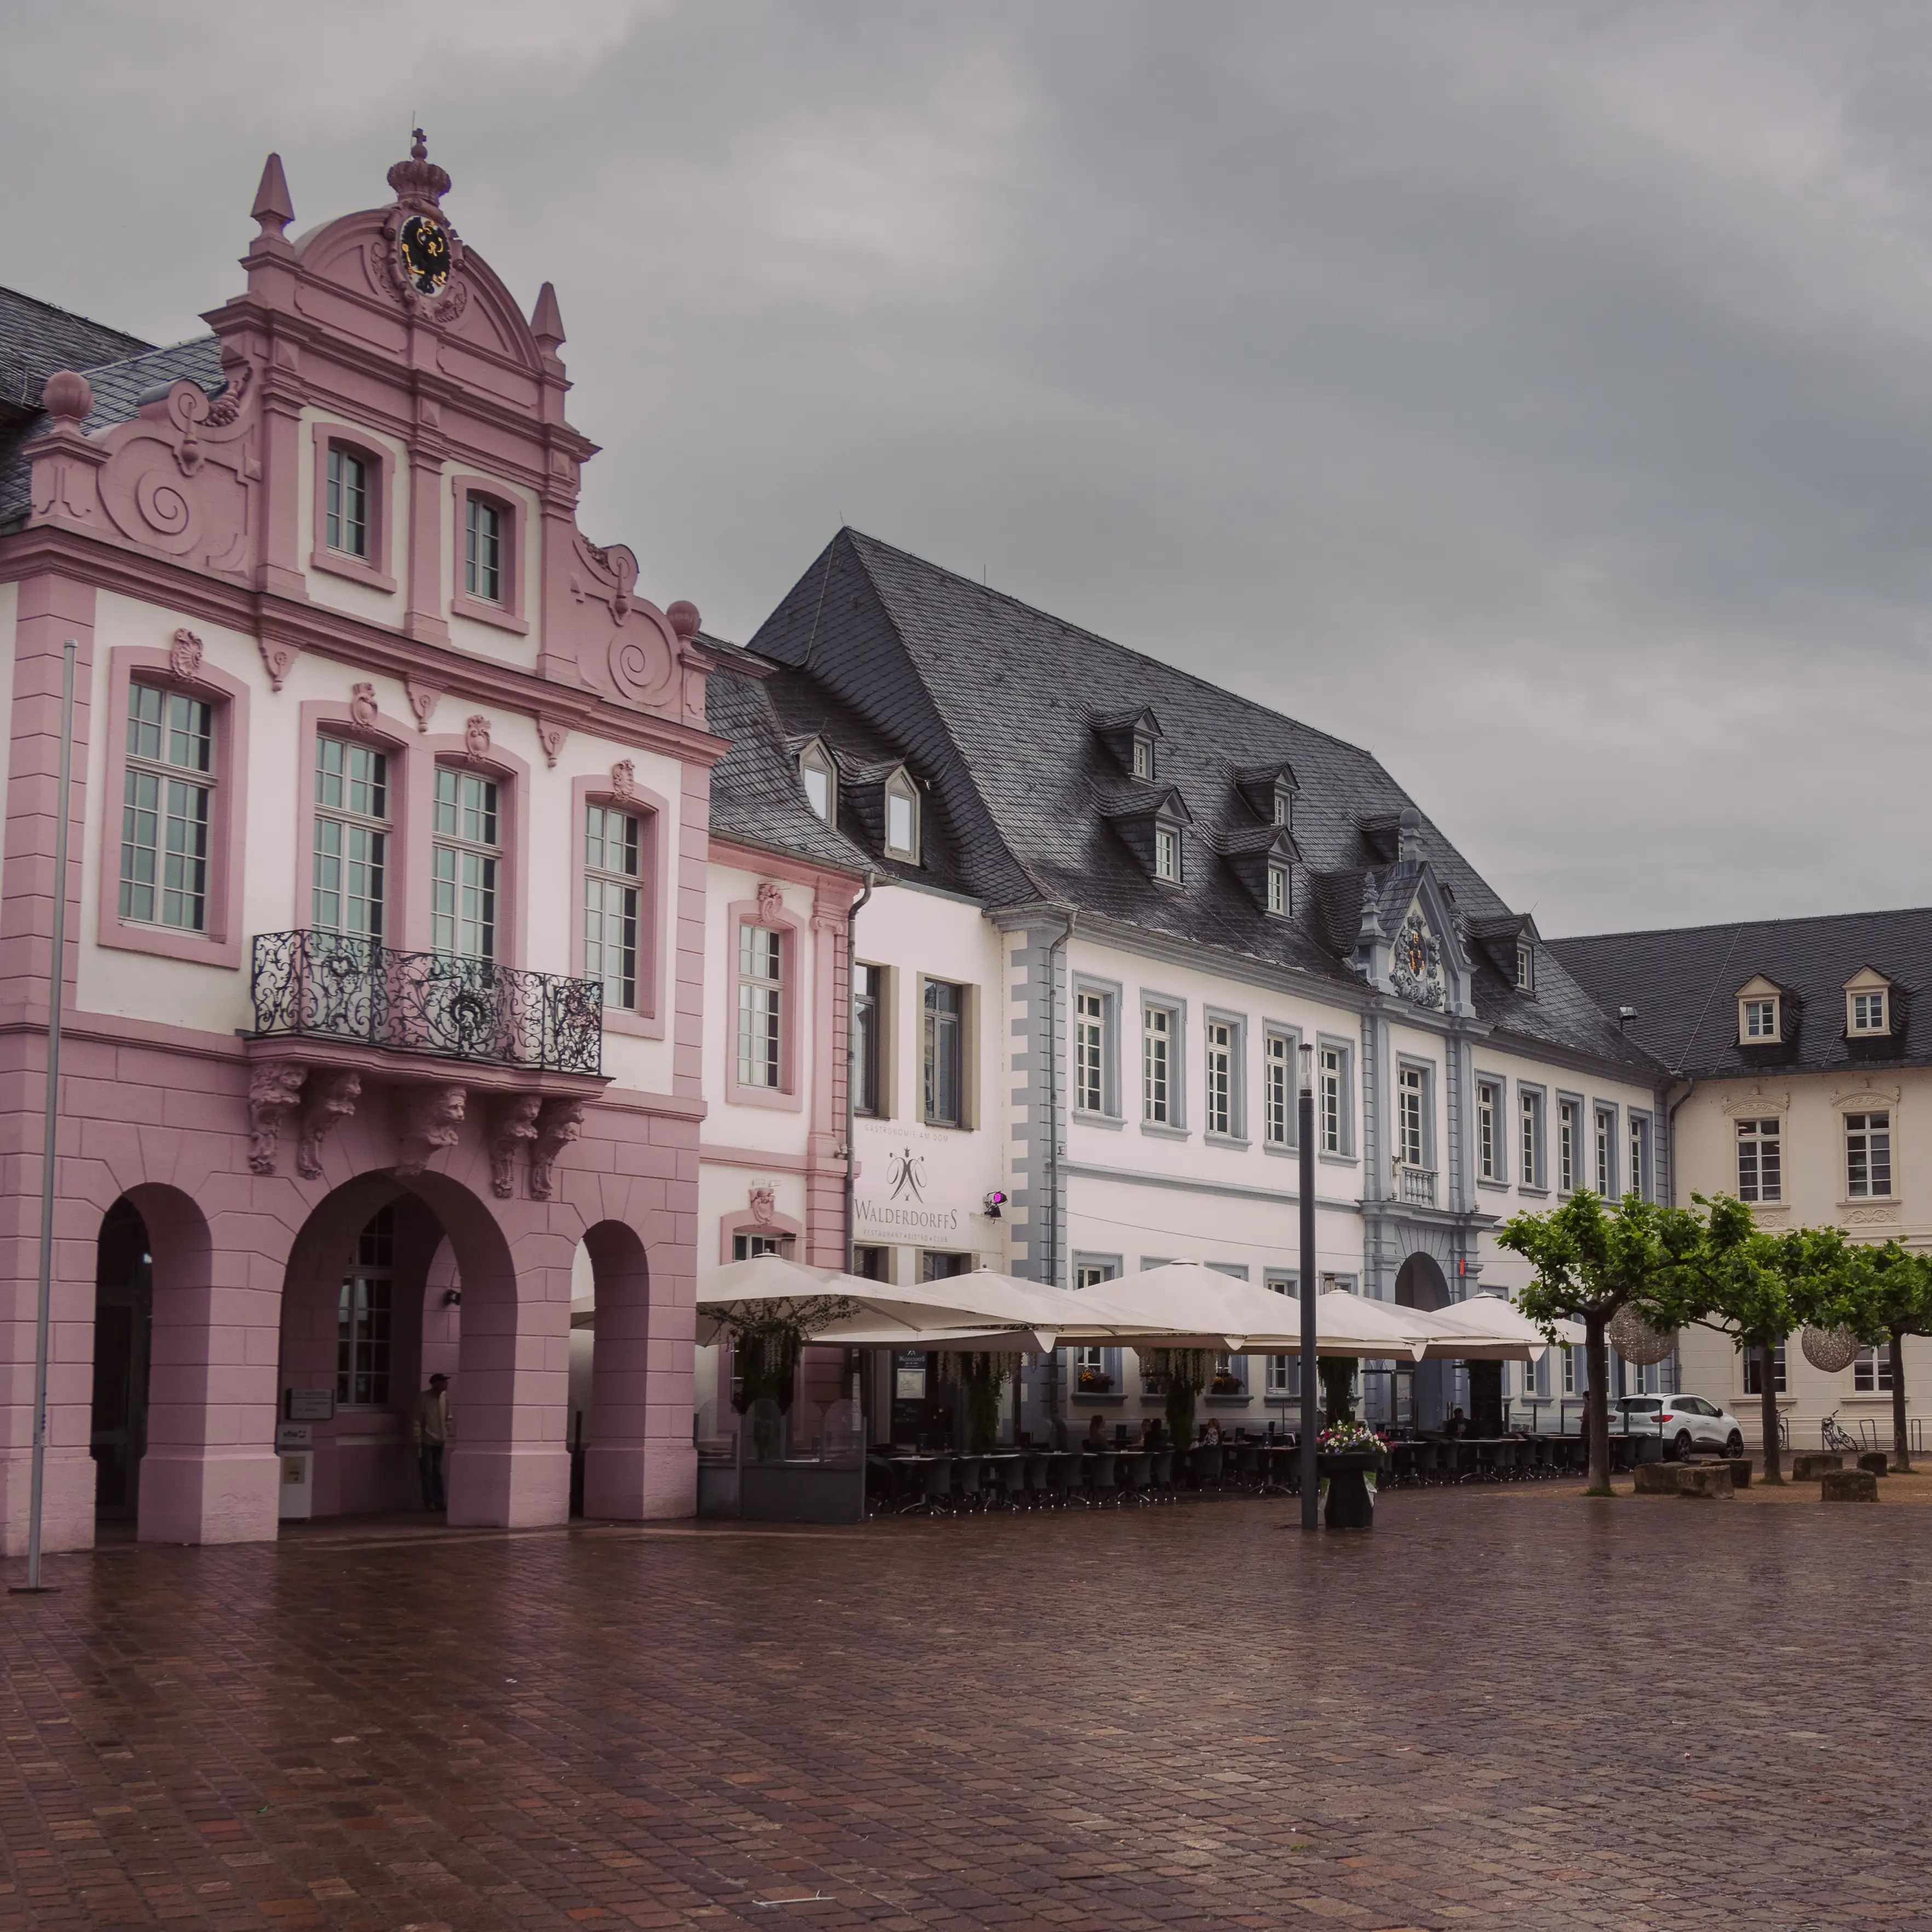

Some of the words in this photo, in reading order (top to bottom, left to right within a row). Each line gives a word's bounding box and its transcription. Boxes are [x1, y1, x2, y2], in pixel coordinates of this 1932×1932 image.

[864, 1124, 916, 1138] GASTRONOMIE
[933, 1134, 948, 1142] DOM
[854, 1198, 958, 1230] WALDERDORFFS
[863, 1230, 903, 1238] RESTAURANT
[908, 1233, 928, 1241] BISTRO
